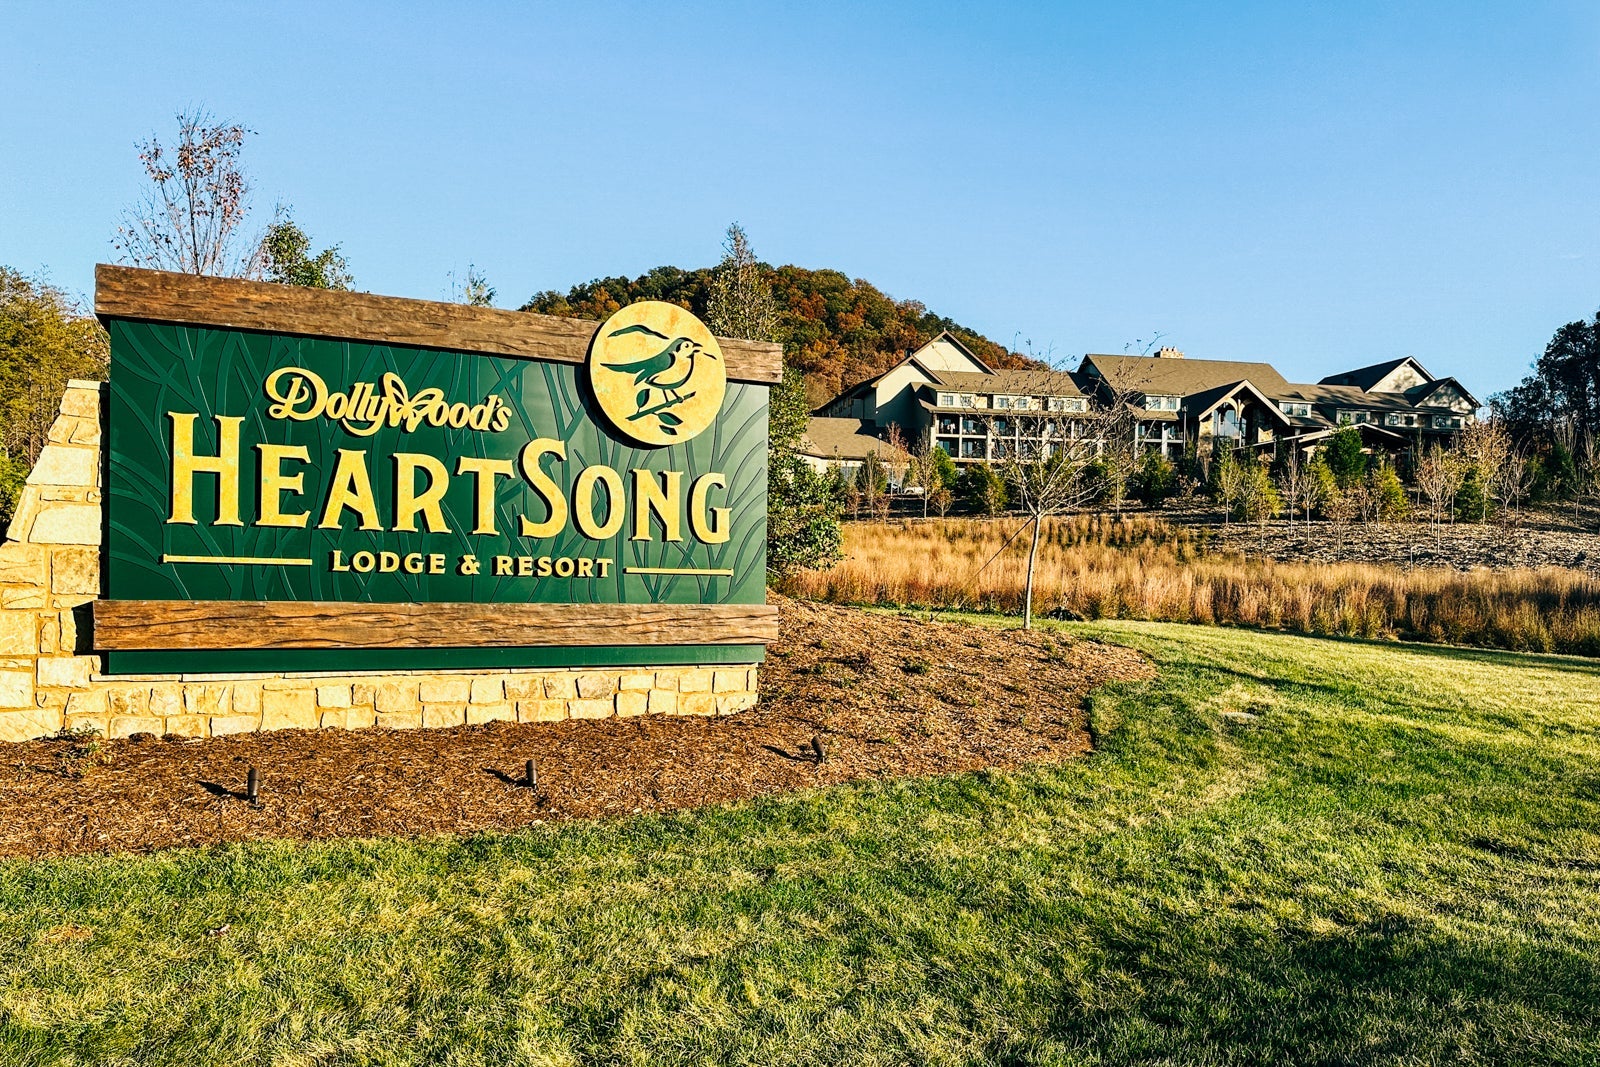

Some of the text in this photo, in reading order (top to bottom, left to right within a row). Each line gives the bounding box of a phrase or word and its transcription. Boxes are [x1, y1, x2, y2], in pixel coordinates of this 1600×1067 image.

[332, 550, 613, 578] LODGE & RESORT
